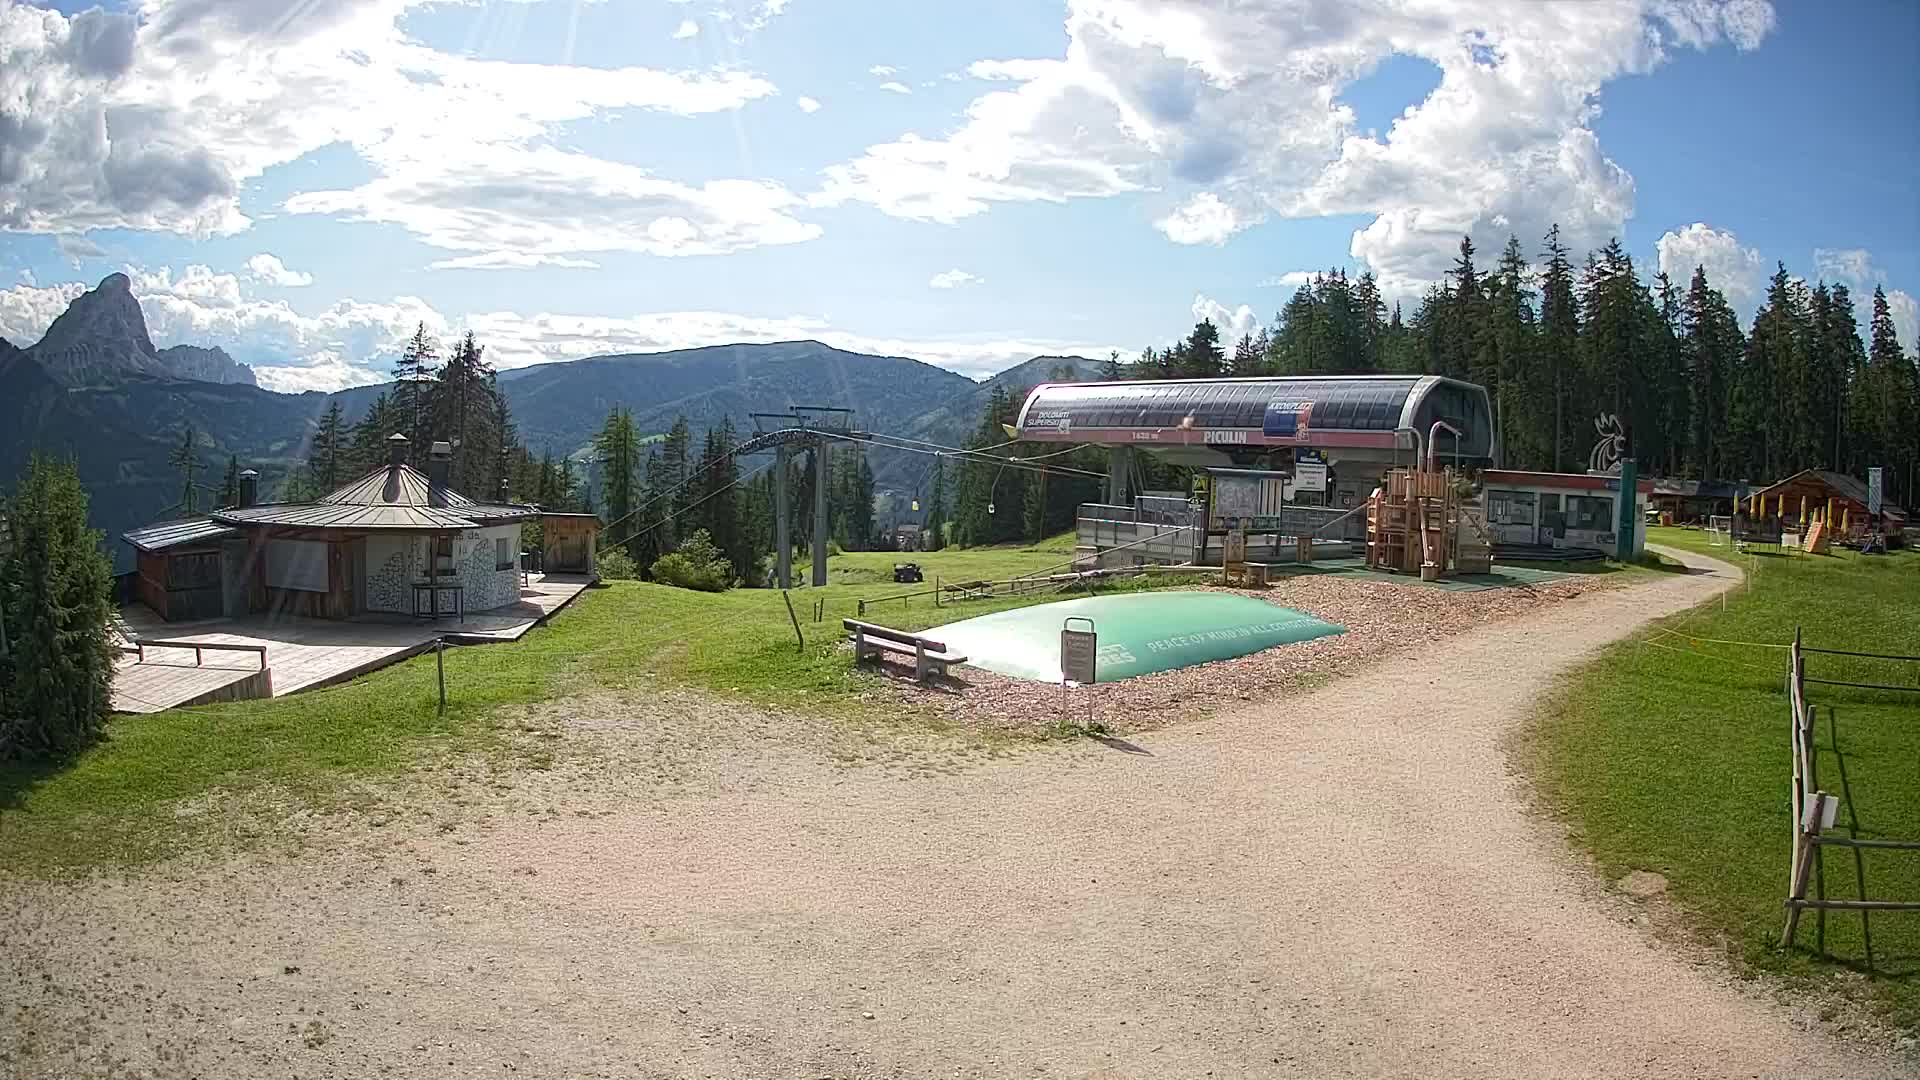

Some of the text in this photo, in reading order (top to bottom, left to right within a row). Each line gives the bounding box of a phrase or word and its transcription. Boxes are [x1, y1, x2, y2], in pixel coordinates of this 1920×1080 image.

[1038, 411, 1070, 419] DOLOMITI
[1203, 430, 1247, 444] PICULIN
[1146, 636, 1186, 653] PEACE
[1189, 633, 1205, 644] OF
[1206, 630, 1237, 641] MIND
